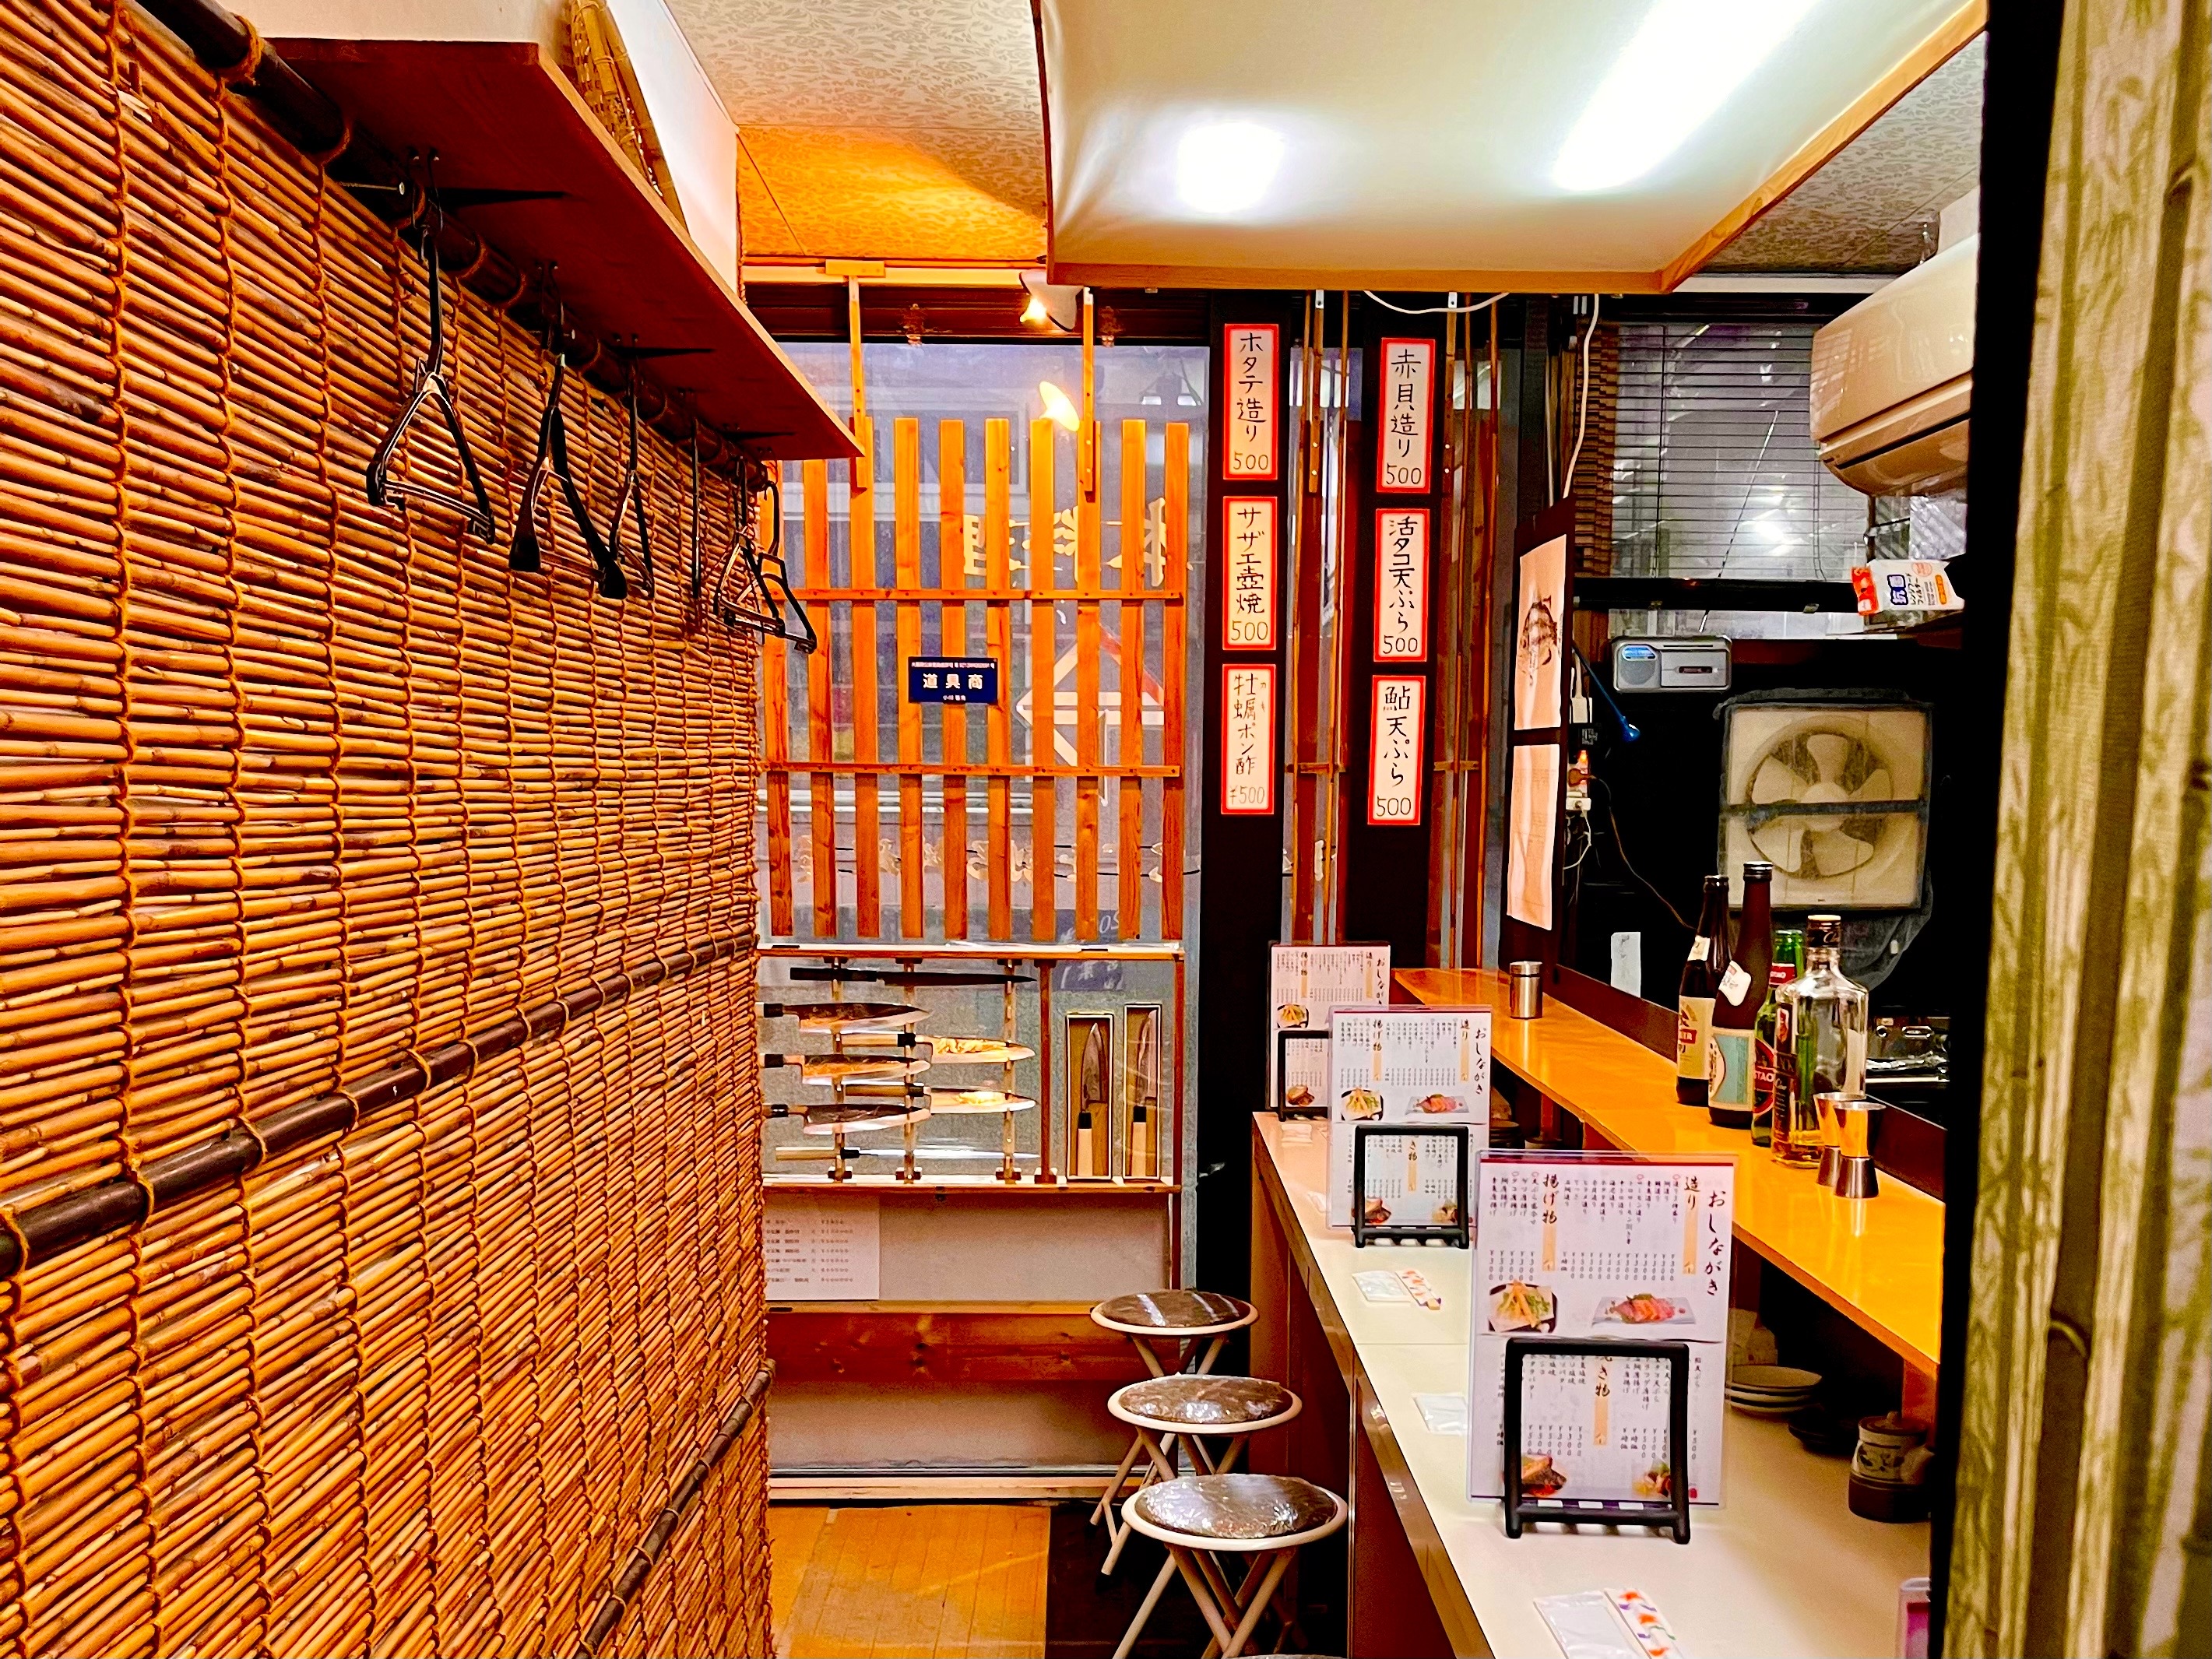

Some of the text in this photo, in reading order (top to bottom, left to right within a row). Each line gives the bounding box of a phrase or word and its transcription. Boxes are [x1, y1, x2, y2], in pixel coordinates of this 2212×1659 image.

[1236, 332, 1267, 443] ホタテ造り
[1391, 348, 1422, 458] 赤貝造り
[1233, 452, 1269, 470] 500
[1386, 462, 1422, 485] 500
[1236, 507, 1265, 614] サザエ壺焼
[1389, 515, 1418, 634] 活タコ天ぷら
[1230, 619, 1268, 641] 500
[1383, 634, 1418, 655] 500
[923, 673, 983, 689] 道具商
[1383, 685, 1410, 787] 鮎天ぷら
[1229, 785, 1265, 805] ¥500
[1376, 796, 1412, 817] 500
[1474, 1027, 1487, 1095] おしながき
[1542, 1173, 1559, 1224] 揚げ物
[1684, 1176, 1700, 1210] 造り
[1704, 1190, 1727, 1296] おしながき
[1595, 1358, 1612, 1397] き物
